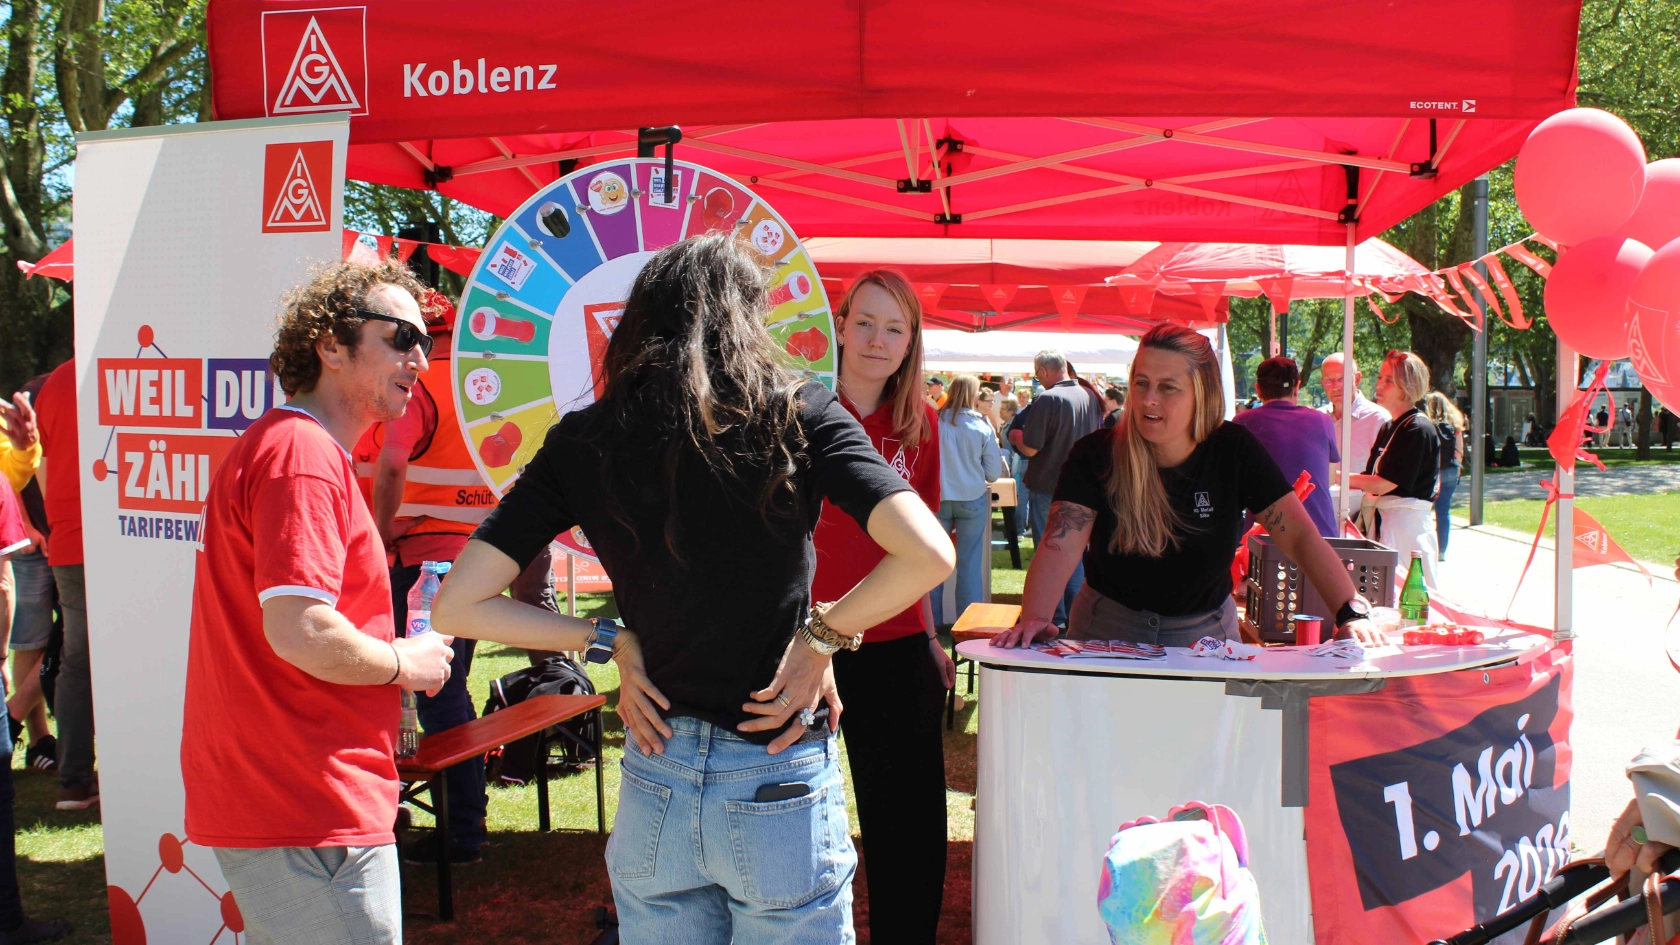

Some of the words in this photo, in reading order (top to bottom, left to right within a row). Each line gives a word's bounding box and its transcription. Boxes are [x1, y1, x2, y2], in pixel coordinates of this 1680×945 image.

[403, 57, 558, 98] Koblenz
[1409, 101, 1457, 110] ECOTENT
[105, 369, 194, 417] WEIL
[215, 370, 266, 419] DU
[455, 489, 495, 506] Schüt
[1383, 781, 1440, 860] 1.
[1452, 713, 1535, 837] Mai
